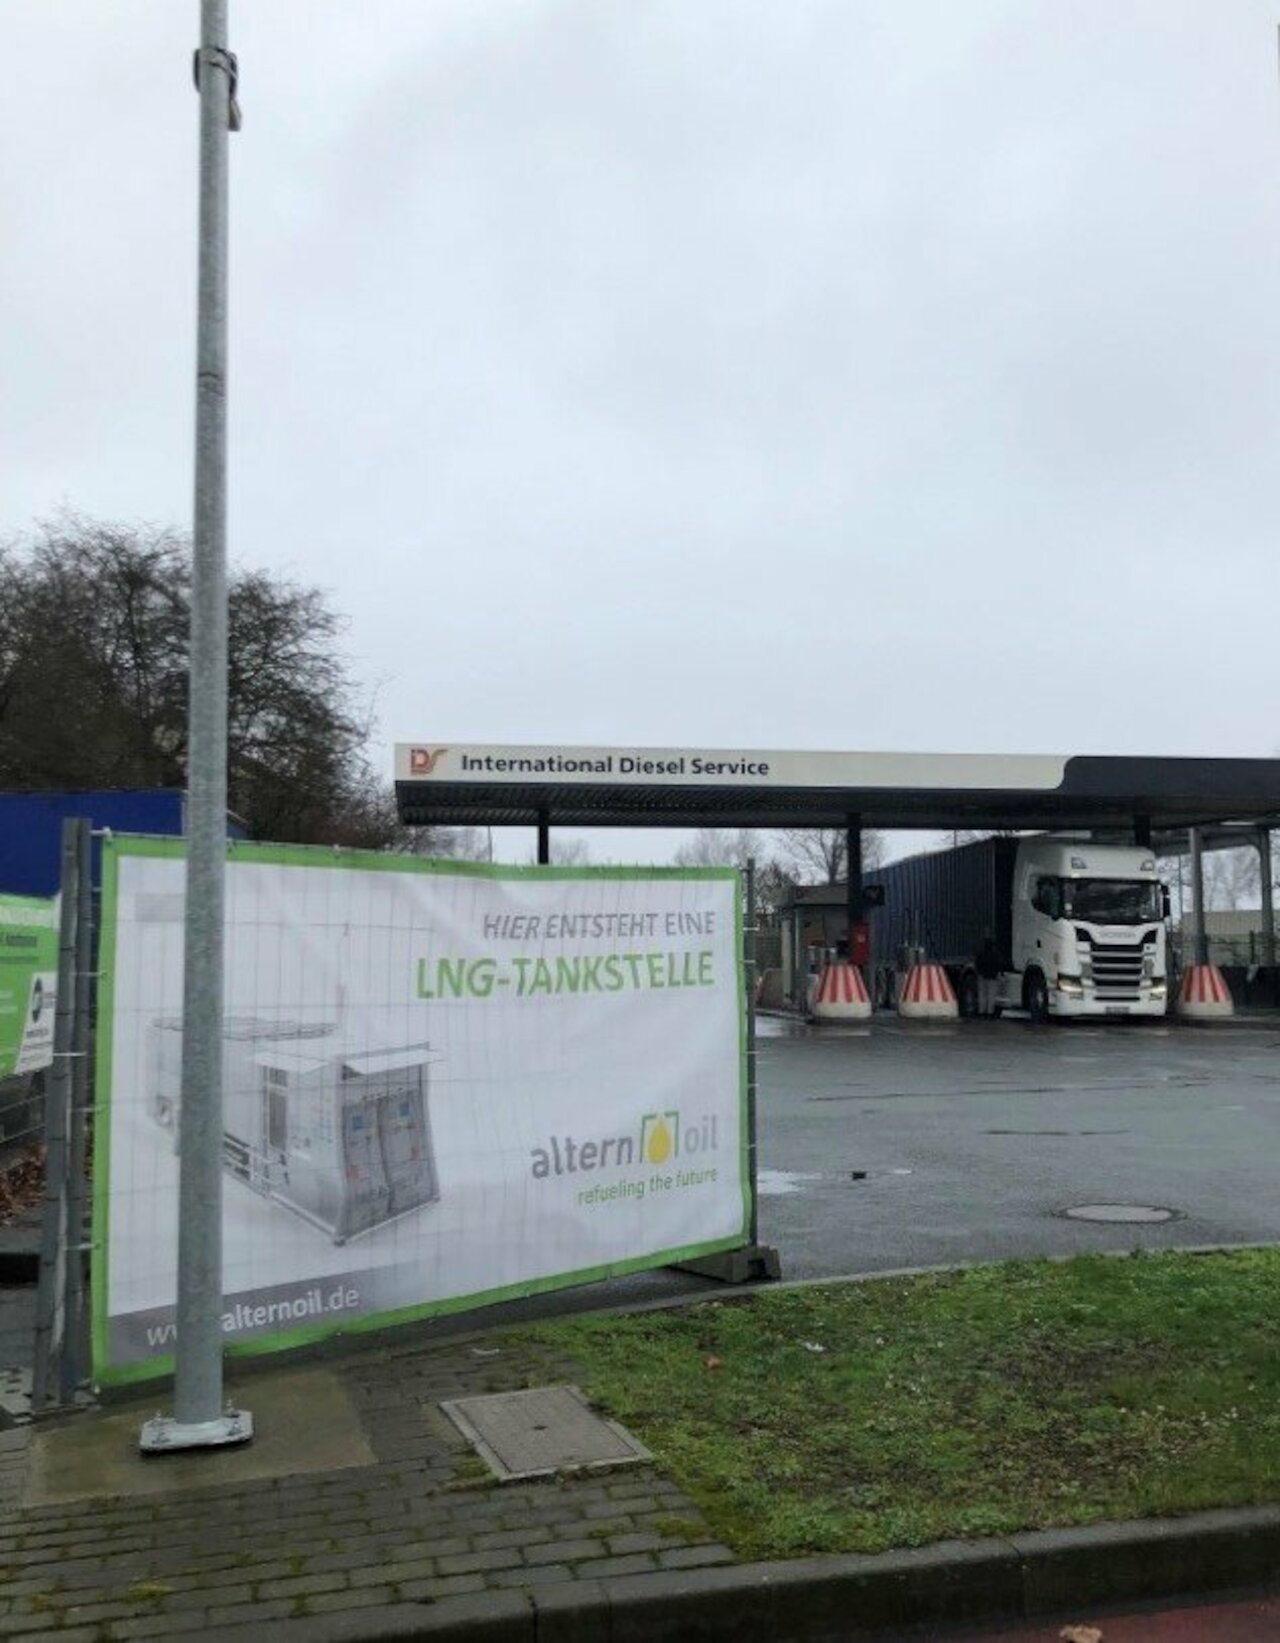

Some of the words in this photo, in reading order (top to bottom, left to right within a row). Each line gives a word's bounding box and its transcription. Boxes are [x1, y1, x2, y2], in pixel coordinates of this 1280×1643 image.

[461, 753, 613, 774] International
[619, 756, 685, 775] Diesel
[690, 757, 770, 776] Service
[483, 914, 541, 940] HIER
[544, 912, 659, 939] ENTSTEHT
[665, 911, 716, 936] EINE
[416, 951, 716, 999] LNG-TANKSTELLE
[530, 1135, 633, 1179] altern
[684, 1114, 719, 1154] oil
[649, 1174, 673, 1192] the
[676, 1168, 717, 1188] future
